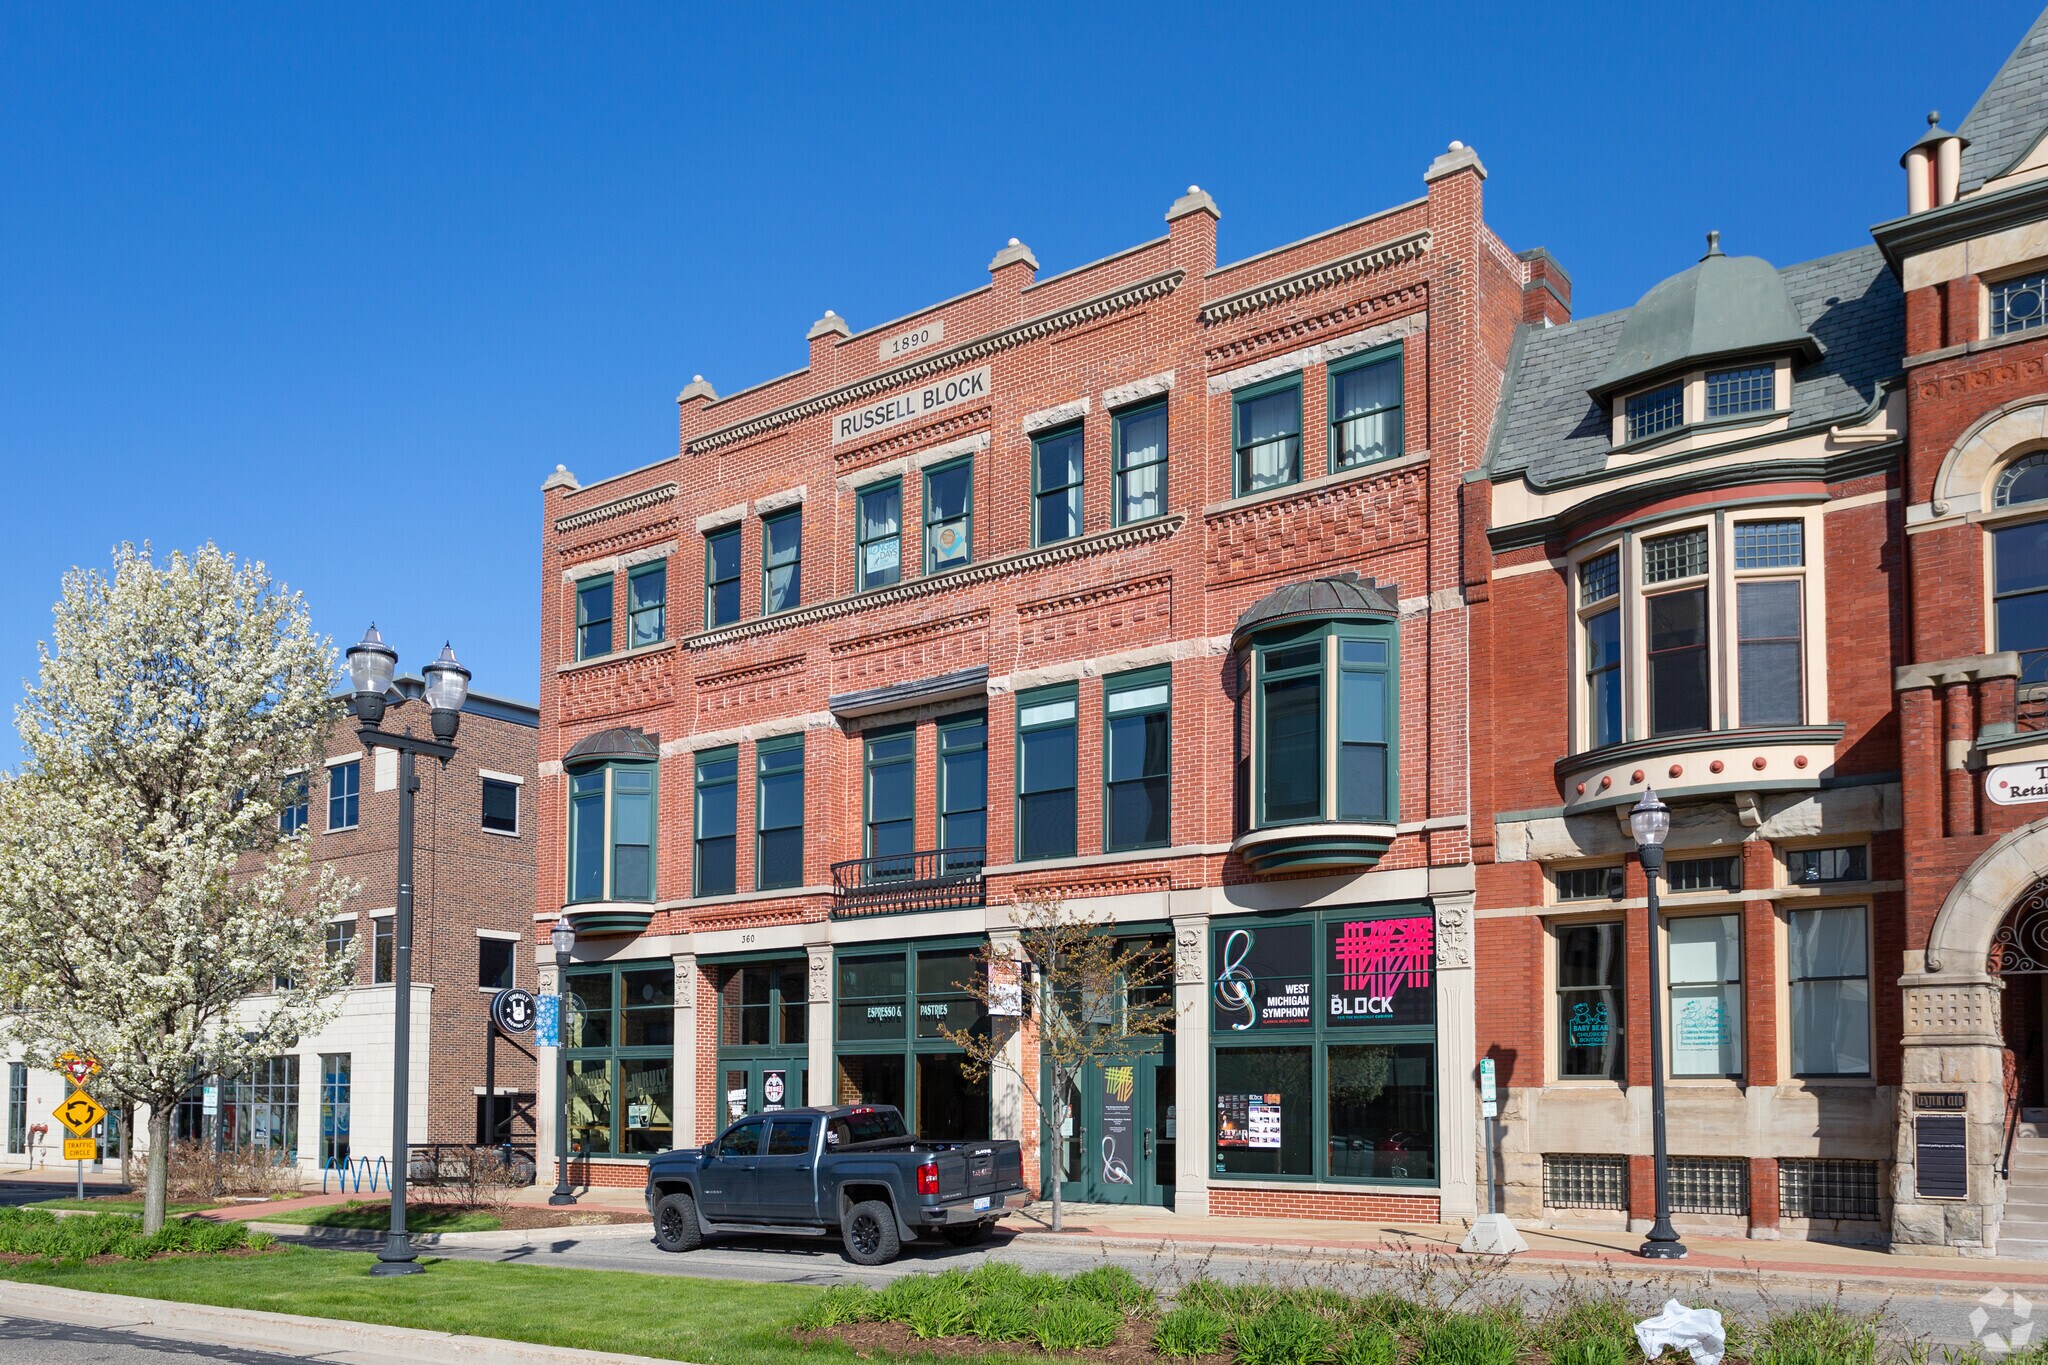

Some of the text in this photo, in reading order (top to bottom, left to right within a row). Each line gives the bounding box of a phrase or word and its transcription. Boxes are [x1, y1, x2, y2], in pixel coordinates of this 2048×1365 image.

[892, 330, 929, 354] 1890
[840, 372, 983, 437] RUSSELL BLOCK
[880, 549, 897, 559] DAYS
[2035, 766, 2048, 780] T
[741, 934, 755, 944] 360
[1285, 984, 1309, 994] WEST
[508, 993, 529, 1002] UNRULY
[1267, 995, 1309, 1007] MICHIGAN
[920, 1004, 948, 1018] PASTRIES
[1331, 996, 1393, 1015] BLOCK
[867, 1006, 902, 1020] ESPRESSO &
[1262, 1007, 1309, 1018] SYMPHONY
[506, 1017, 524, 1028] BREWING
[1916, 1095, 1964, 1106] CENTURY CLUB
